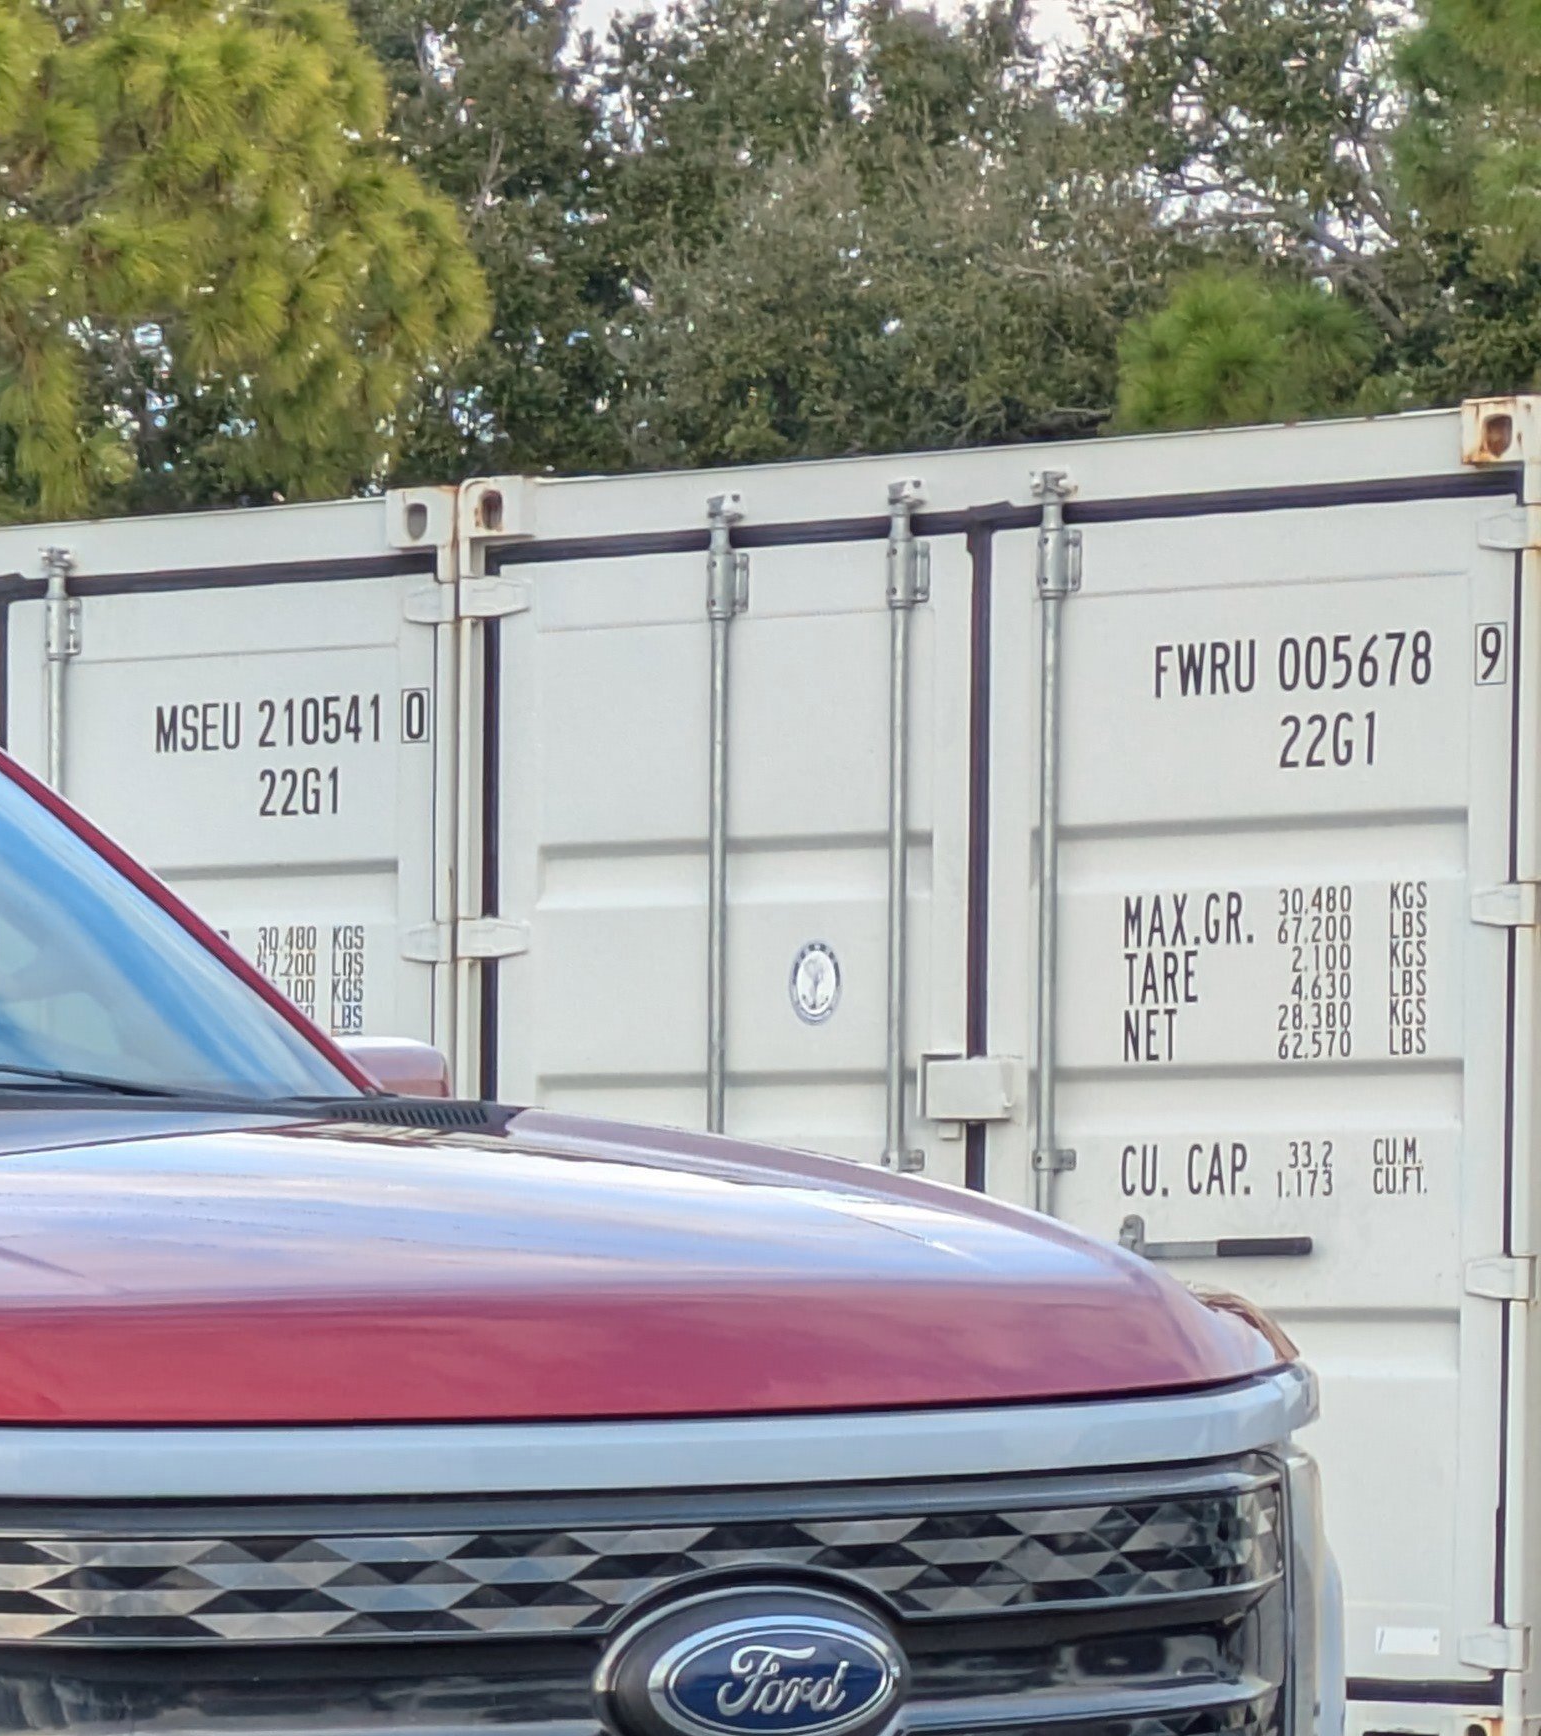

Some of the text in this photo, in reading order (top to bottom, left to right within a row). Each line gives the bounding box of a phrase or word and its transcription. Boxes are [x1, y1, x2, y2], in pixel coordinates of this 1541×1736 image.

[1154, 625, 1502, 699] FWRU 005678 9
[155, 701, 241, 753] MSEU
[258, 693, 380, 747] 210541
[1279, 710, 1376, 768] 22G1
[259, 766, 339, 816] 22G1
[1278, 881, 1427, 915] 30.480 KGS
[1123, 891, 1254, 948] MAX.GR.
[1277, 911, 1427, 944] 67.200 LBS
[332, 925, 364, 950] KGS
[1292, 940, 1427, 973] 2.100 KGS
[331, 978, 364, 1003] KGS
[1124, 950, 1198, 1005] TARE
[1291, 969, 1427, 1001] 4.630 LBS
[331, 1003, 363, 1029] LBS
[1277, 998, 1427, 1031] 28.380 KGS
[1123, 1009, 1177, 1062] NET
[1277, 1027, 1427, 1060] 62.570 LBS
[1120, 1142, 1251, 1197] CU. CAP.
[1277, 1168, 1333, 1198] 1.173
[716, 1644, 850, 1717] Ford
